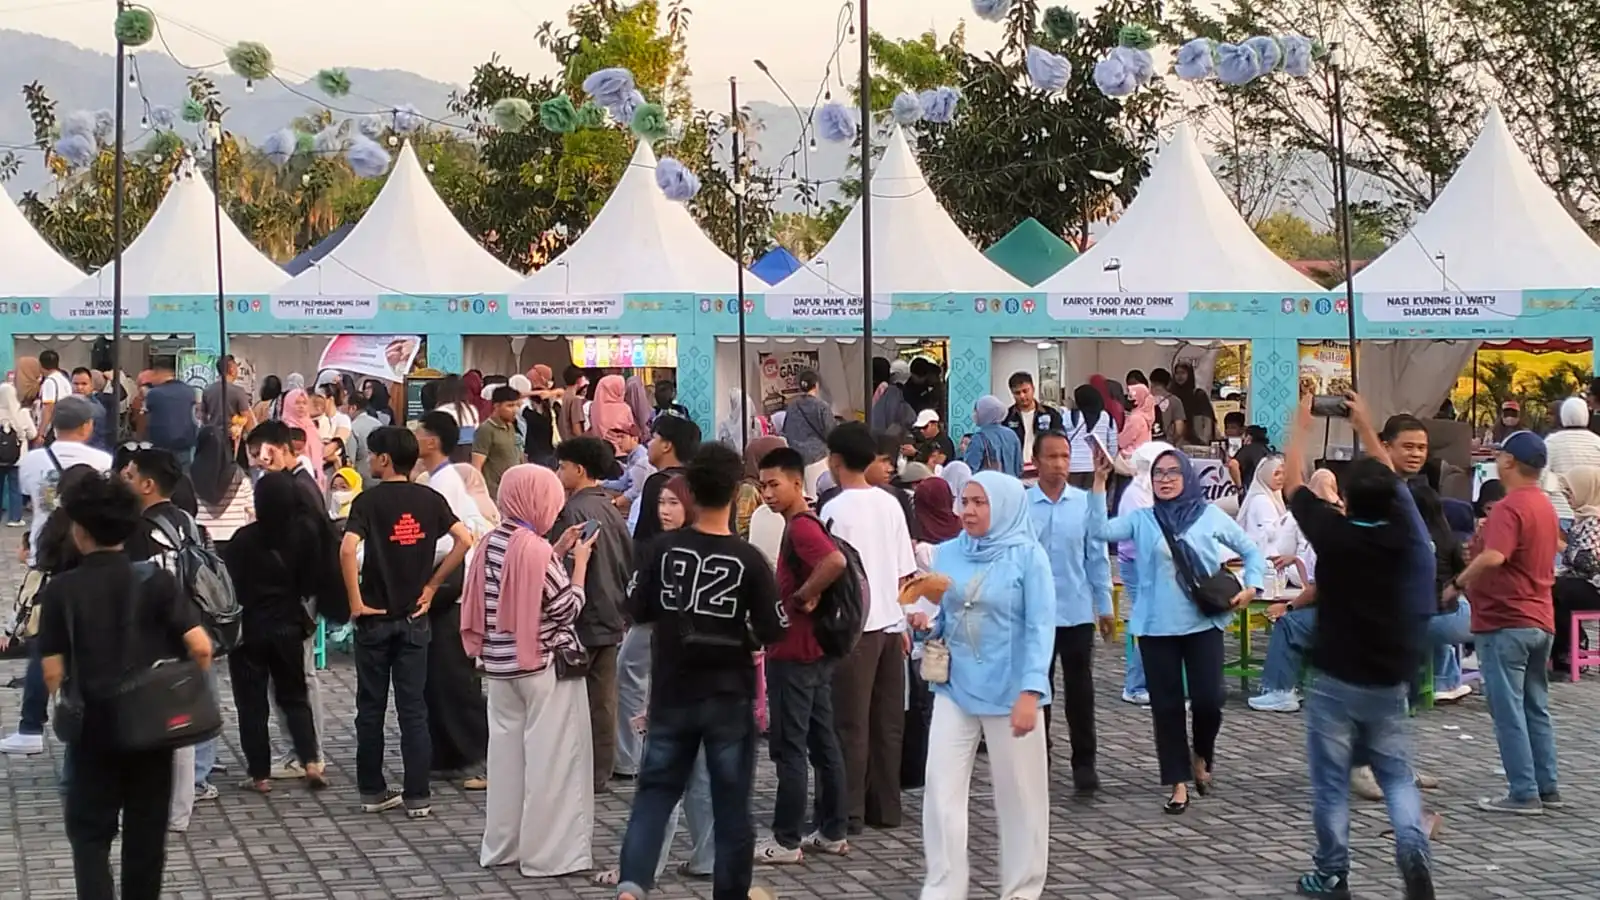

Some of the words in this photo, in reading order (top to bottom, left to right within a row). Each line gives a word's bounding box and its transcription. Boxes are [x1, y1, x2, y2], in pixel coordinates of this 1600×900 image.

[1063, 297, 1094, 305] KAIROS
[1097, 297, 1120, 305] FOOD
[1124, 297, 1143, 305] AND
[1146, 297, 1173, 305] DRINK
[1387, 297, 1409, 305] NASI
[1413, 296, 1451, 305] KUNING
[1467, 296, 1496, 304] WATY
[1090, 308, 1117, 316] YUMMI
[1120, 308, 1146, 316] PLACE
[660, 547, 744, 618] 92
